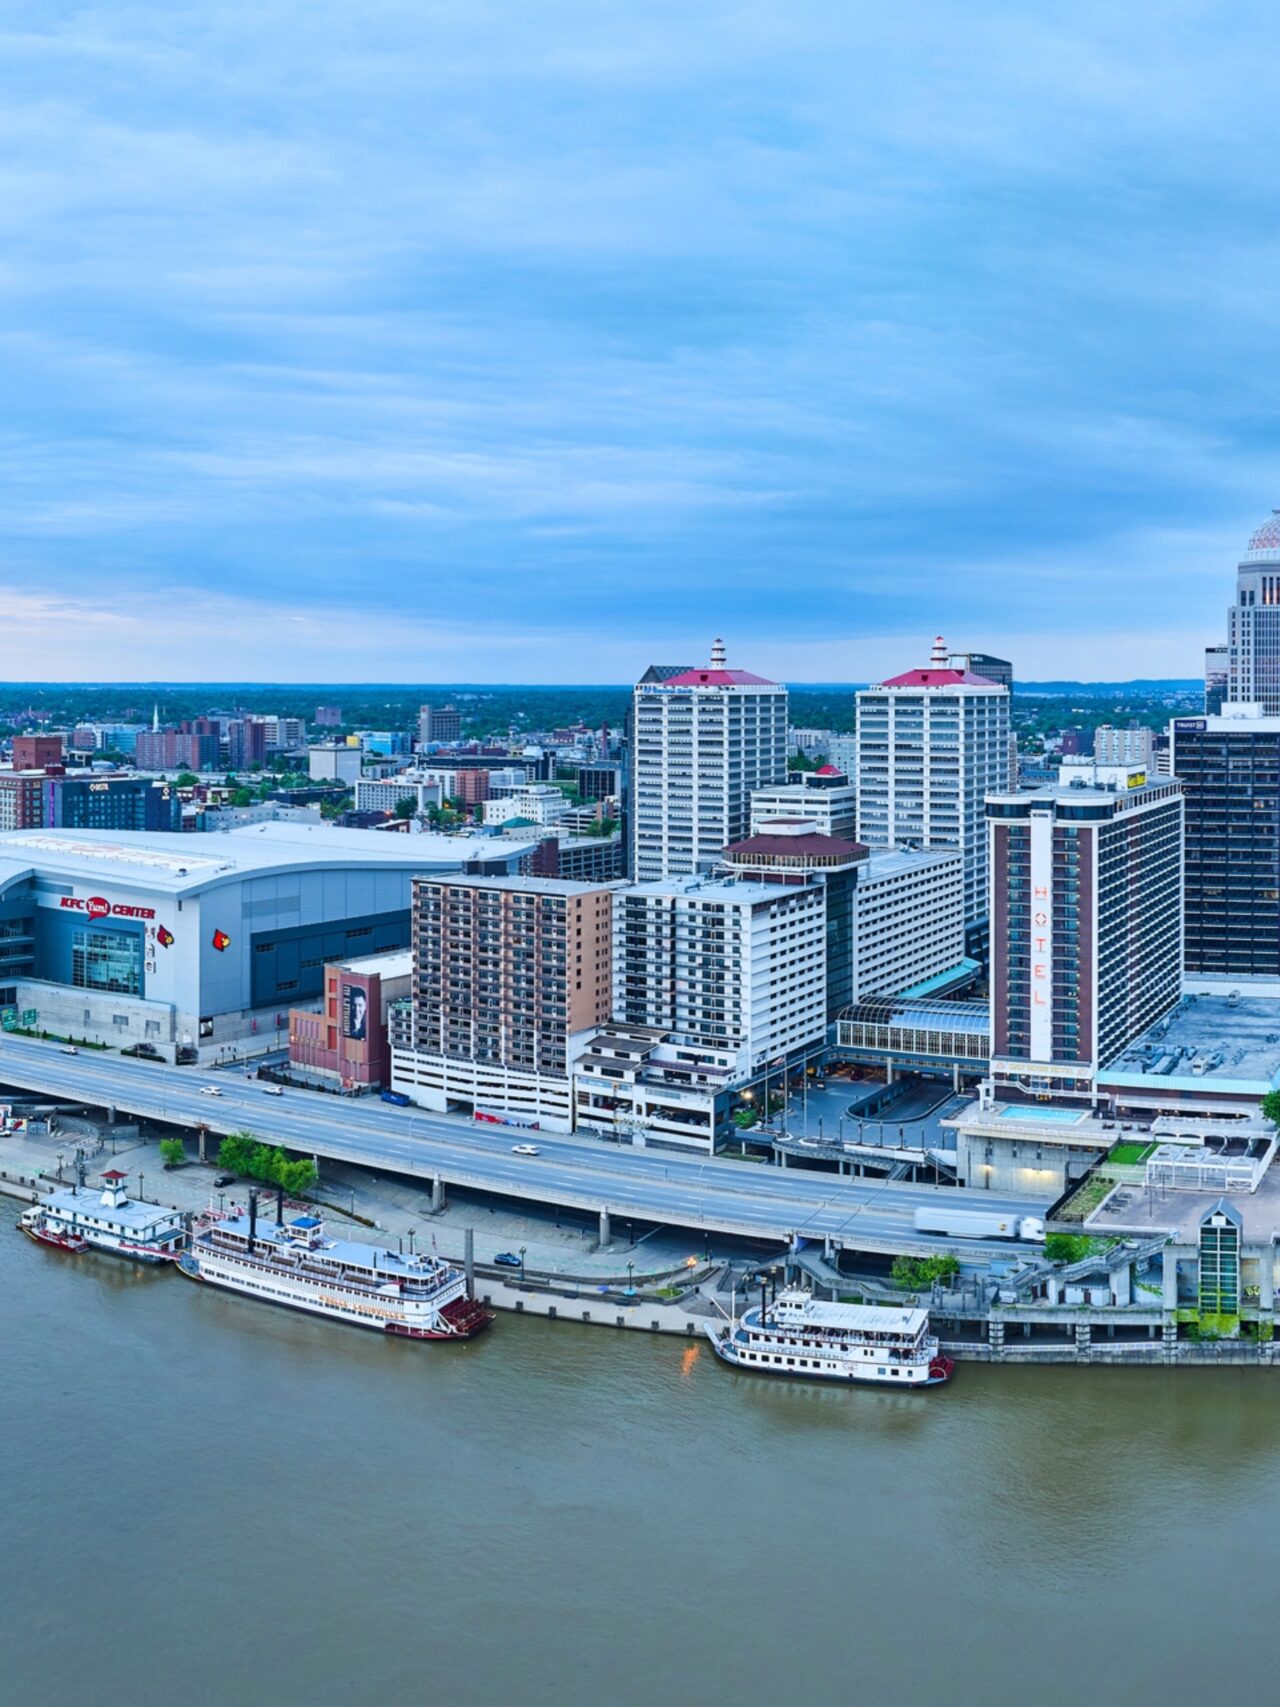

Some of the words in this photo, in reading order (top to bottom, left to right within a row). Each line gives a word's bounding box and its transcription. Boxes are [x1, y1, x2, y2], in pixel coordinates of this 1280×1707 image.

[60, 897, 85, 910] KFC
[88, 900, 108, 914] Yum!
[112, 904, 156, 919] CENTER
[1034, 886, 1048, 1005] HOTEL
